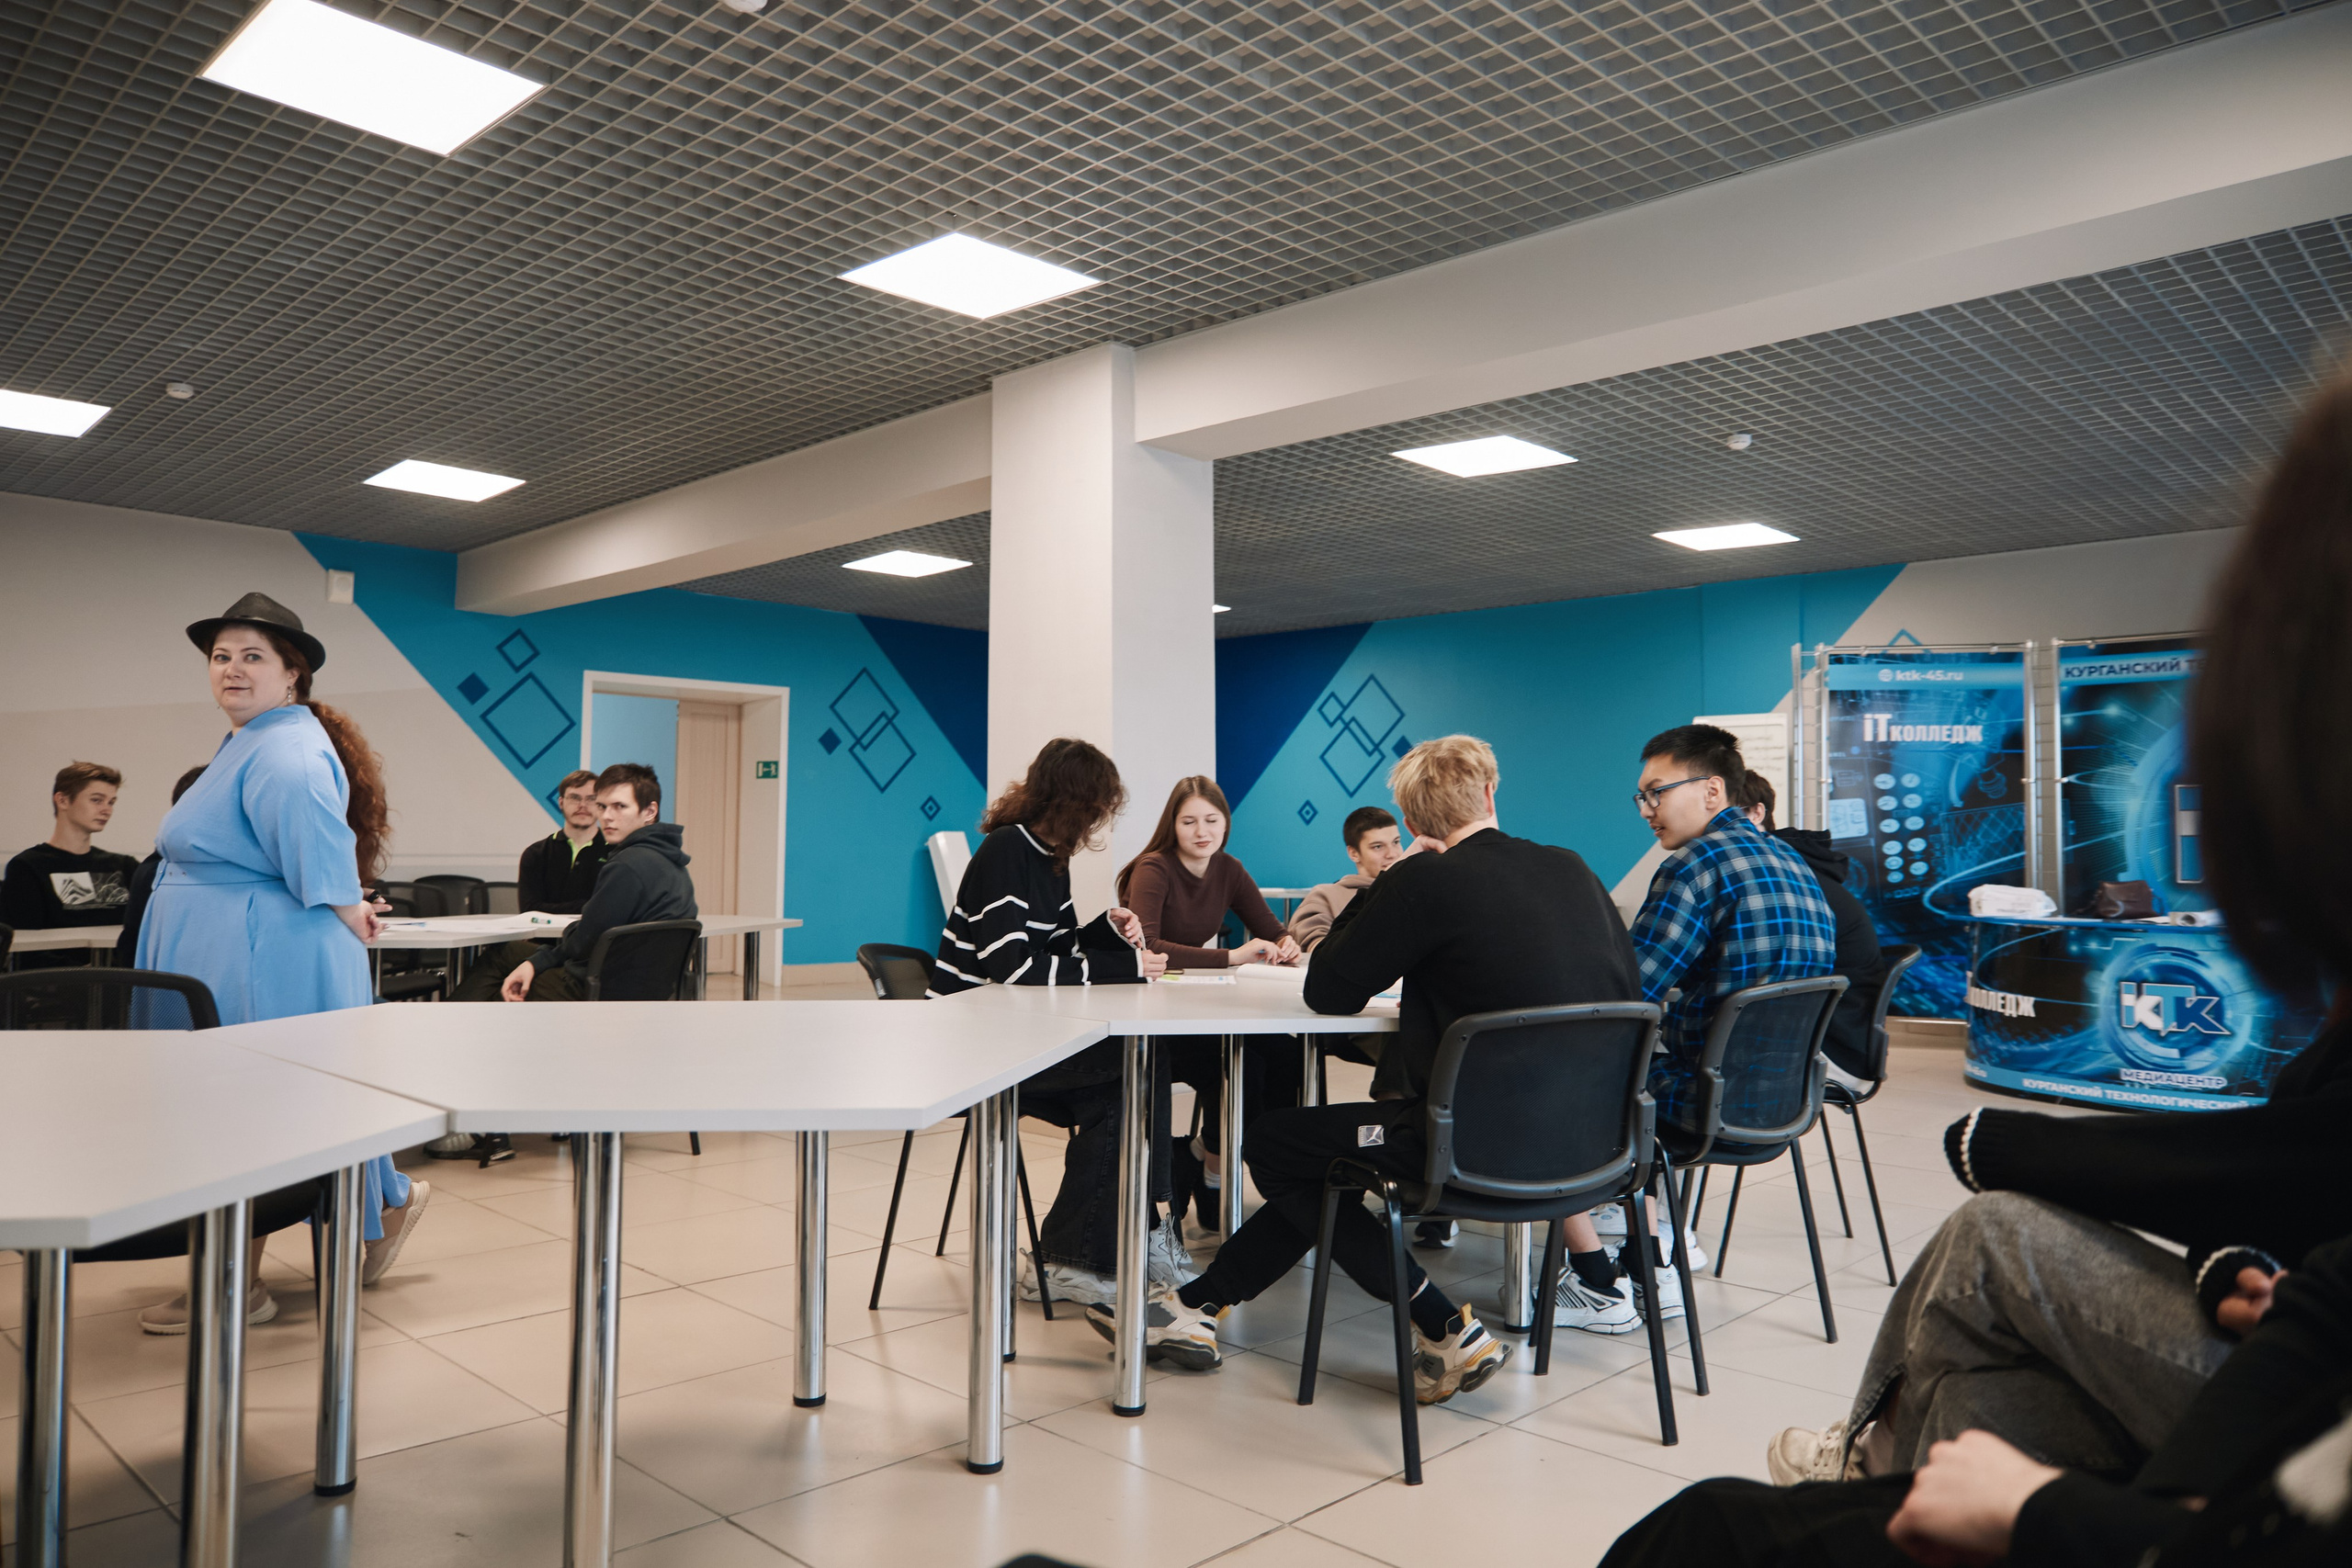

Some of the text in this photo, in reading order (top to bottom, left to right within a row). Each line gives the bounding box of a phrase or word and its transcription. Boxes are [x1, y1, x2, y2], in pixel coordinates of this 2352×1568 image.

[1895, 670, 1964, 682] ktk-45.ru
[2064, 657, 2181, 679] КУРГАНСКИЙ
[2022, 1078, 2103, 1099] КУРГАНСКИЙ
[2121, 1069, 2226, 1088] МЕДИАЦЕНТР
